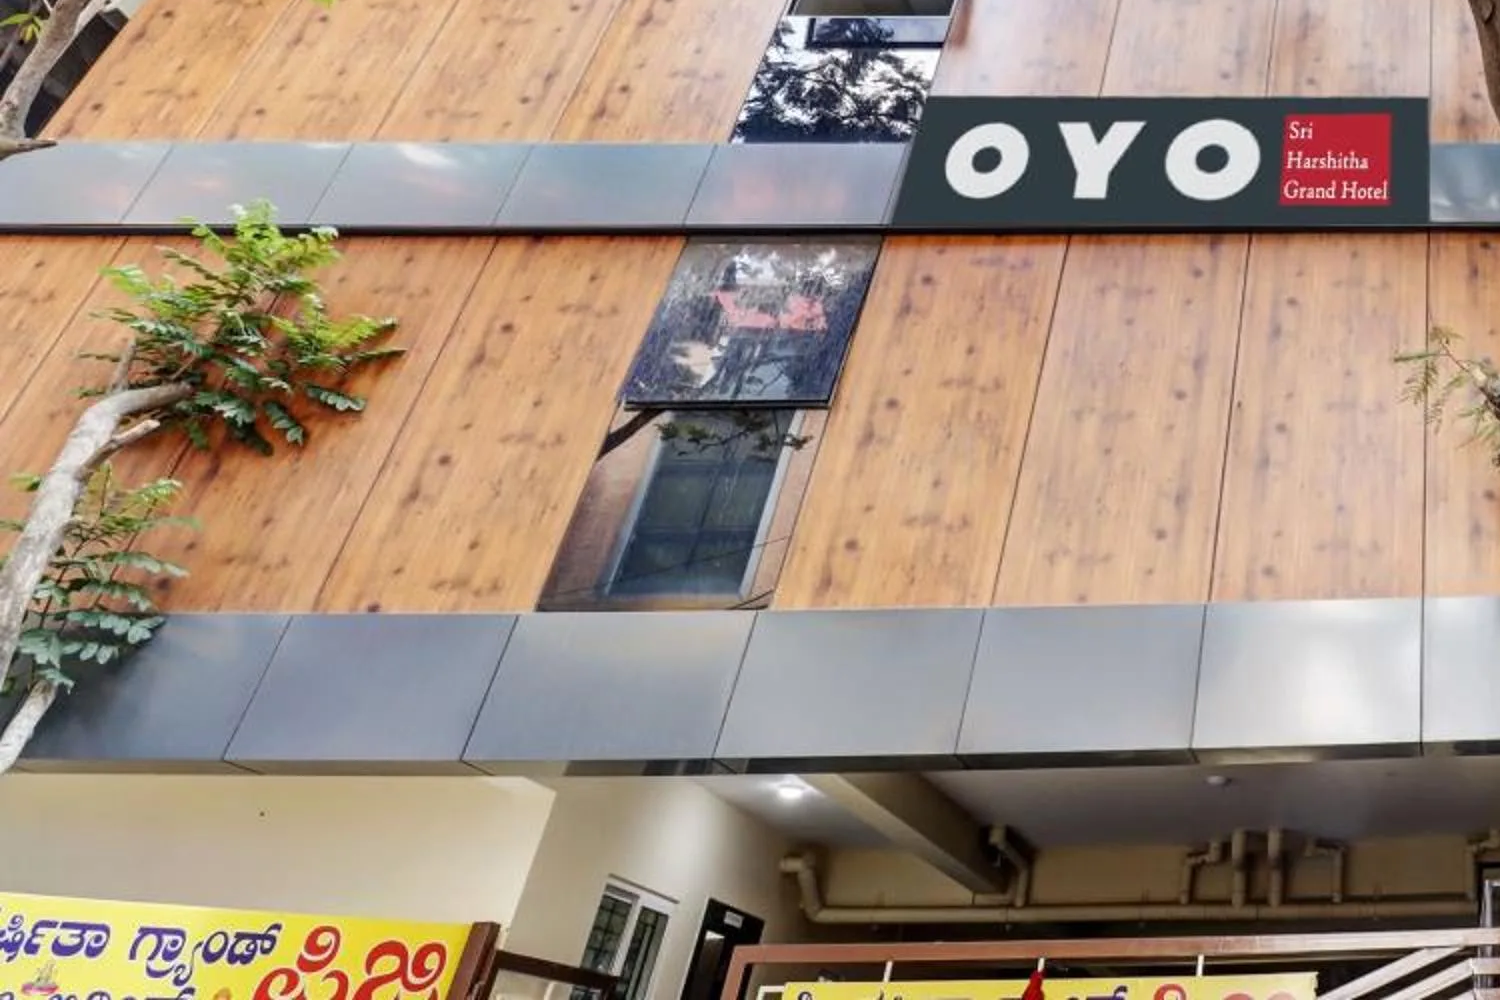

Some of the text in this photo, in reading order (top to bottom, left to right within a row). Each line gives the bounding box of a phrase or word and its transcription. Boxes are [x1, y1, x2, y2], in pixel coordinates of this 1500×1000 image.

[1289, 120, 1313, 139] Sri
[945, 118, 1261, 200] OYO
[1286, 149, 1369, 169] Harshitha
[1283, 179, 1388, 199] Grand Hotel
